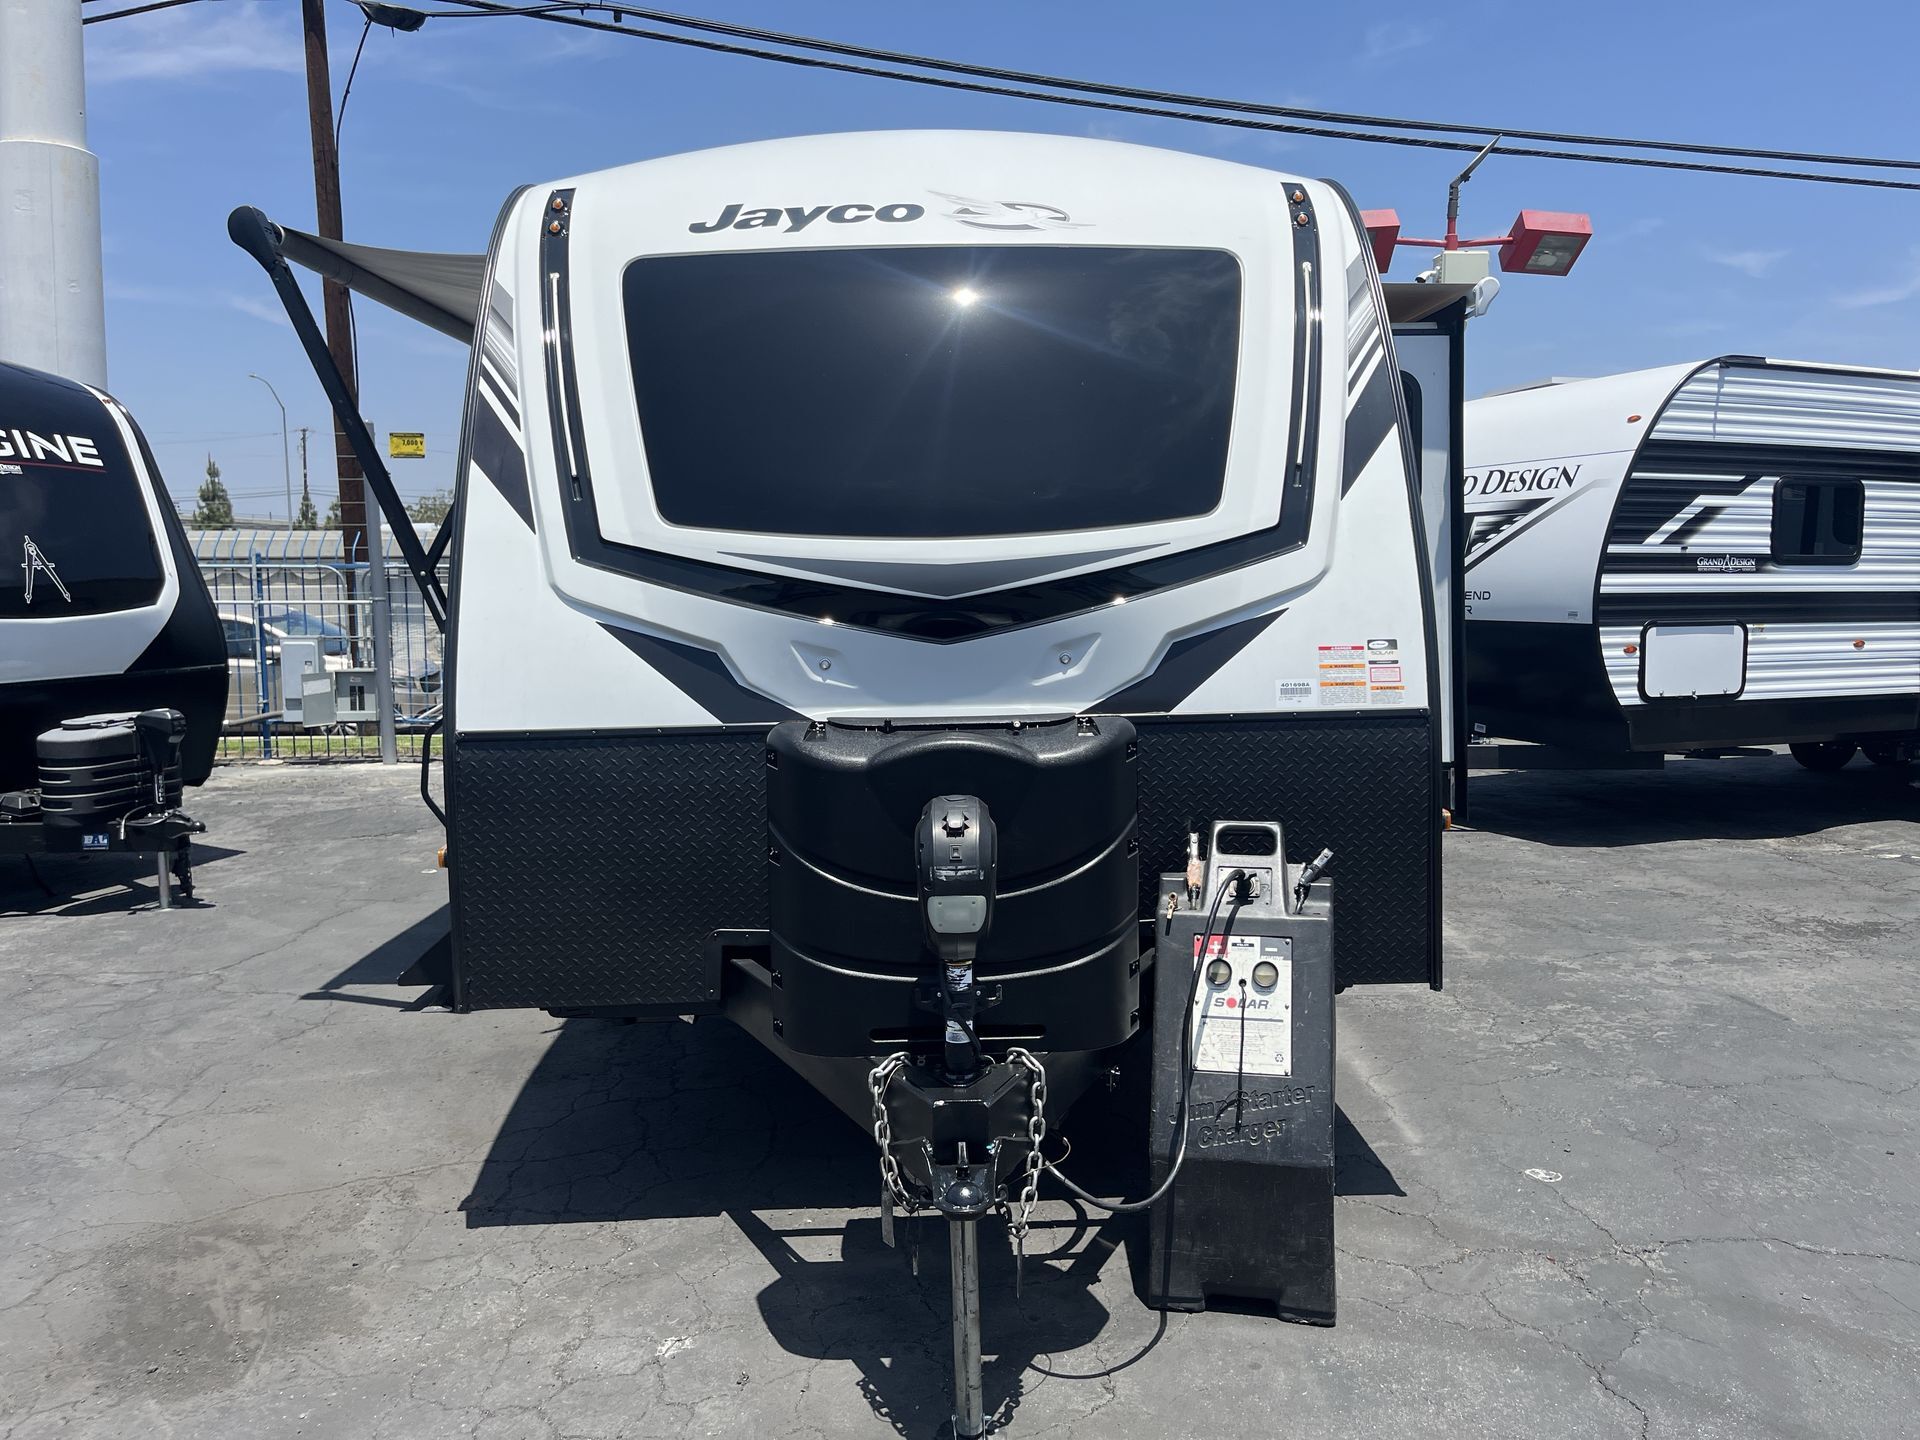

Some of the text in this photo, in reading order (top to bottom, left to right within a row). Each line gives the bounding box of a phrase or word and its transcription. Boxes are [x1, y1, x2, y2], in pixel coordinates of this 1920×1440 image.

[688, 203, 925, 233] Jayco
[1479, 464, 1583, 496] DESIGN
[1696, 556, 1757, 566] GRAND DESIGN
[1465, 590, 1491, 600] END
